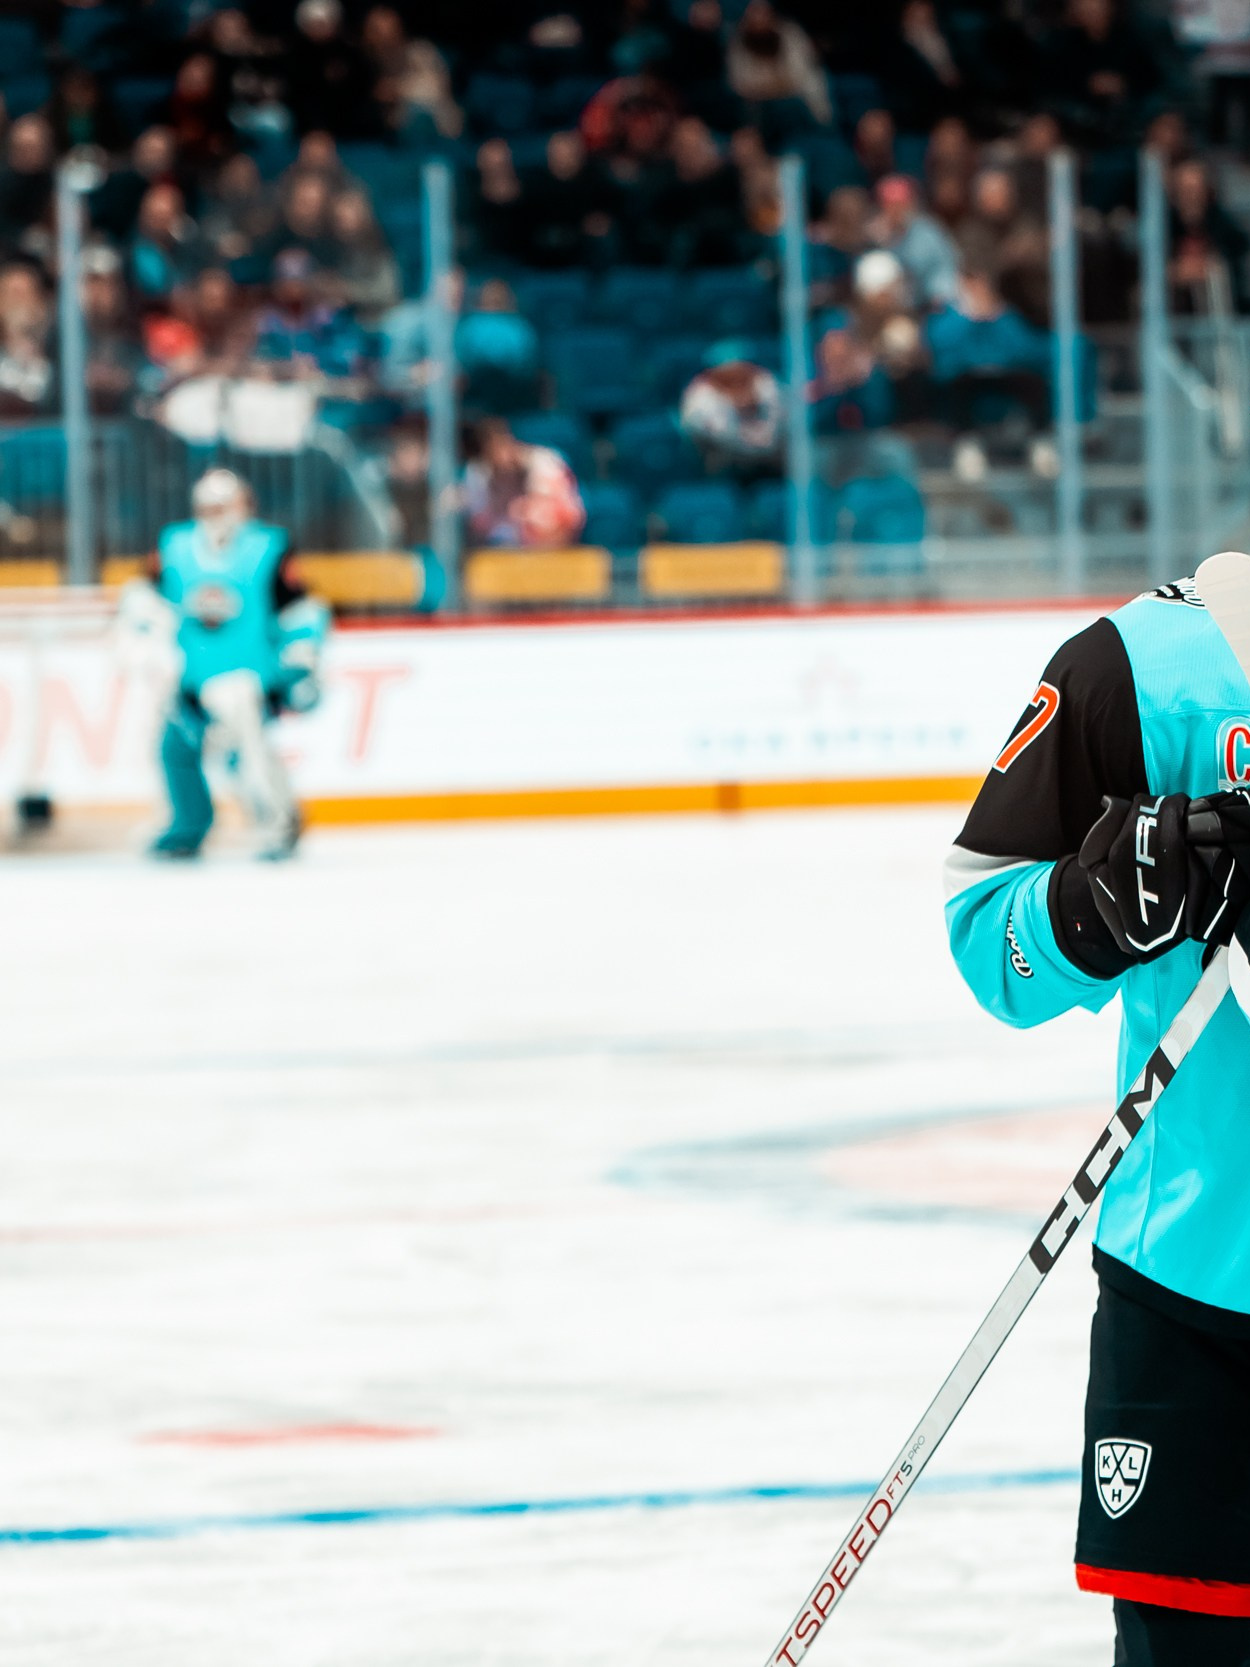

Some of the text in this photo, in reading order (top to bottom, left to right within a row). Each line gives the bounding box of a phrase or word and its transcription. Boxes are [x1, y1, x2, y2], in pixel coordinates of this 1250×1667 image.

[1136, 795, 1166, 926] TRU
[1029, 1045, 1176, 1275] CCM
[769, 1499, 892, 1667] TSPEED
[908, 1435, 926, 1461] PRO
